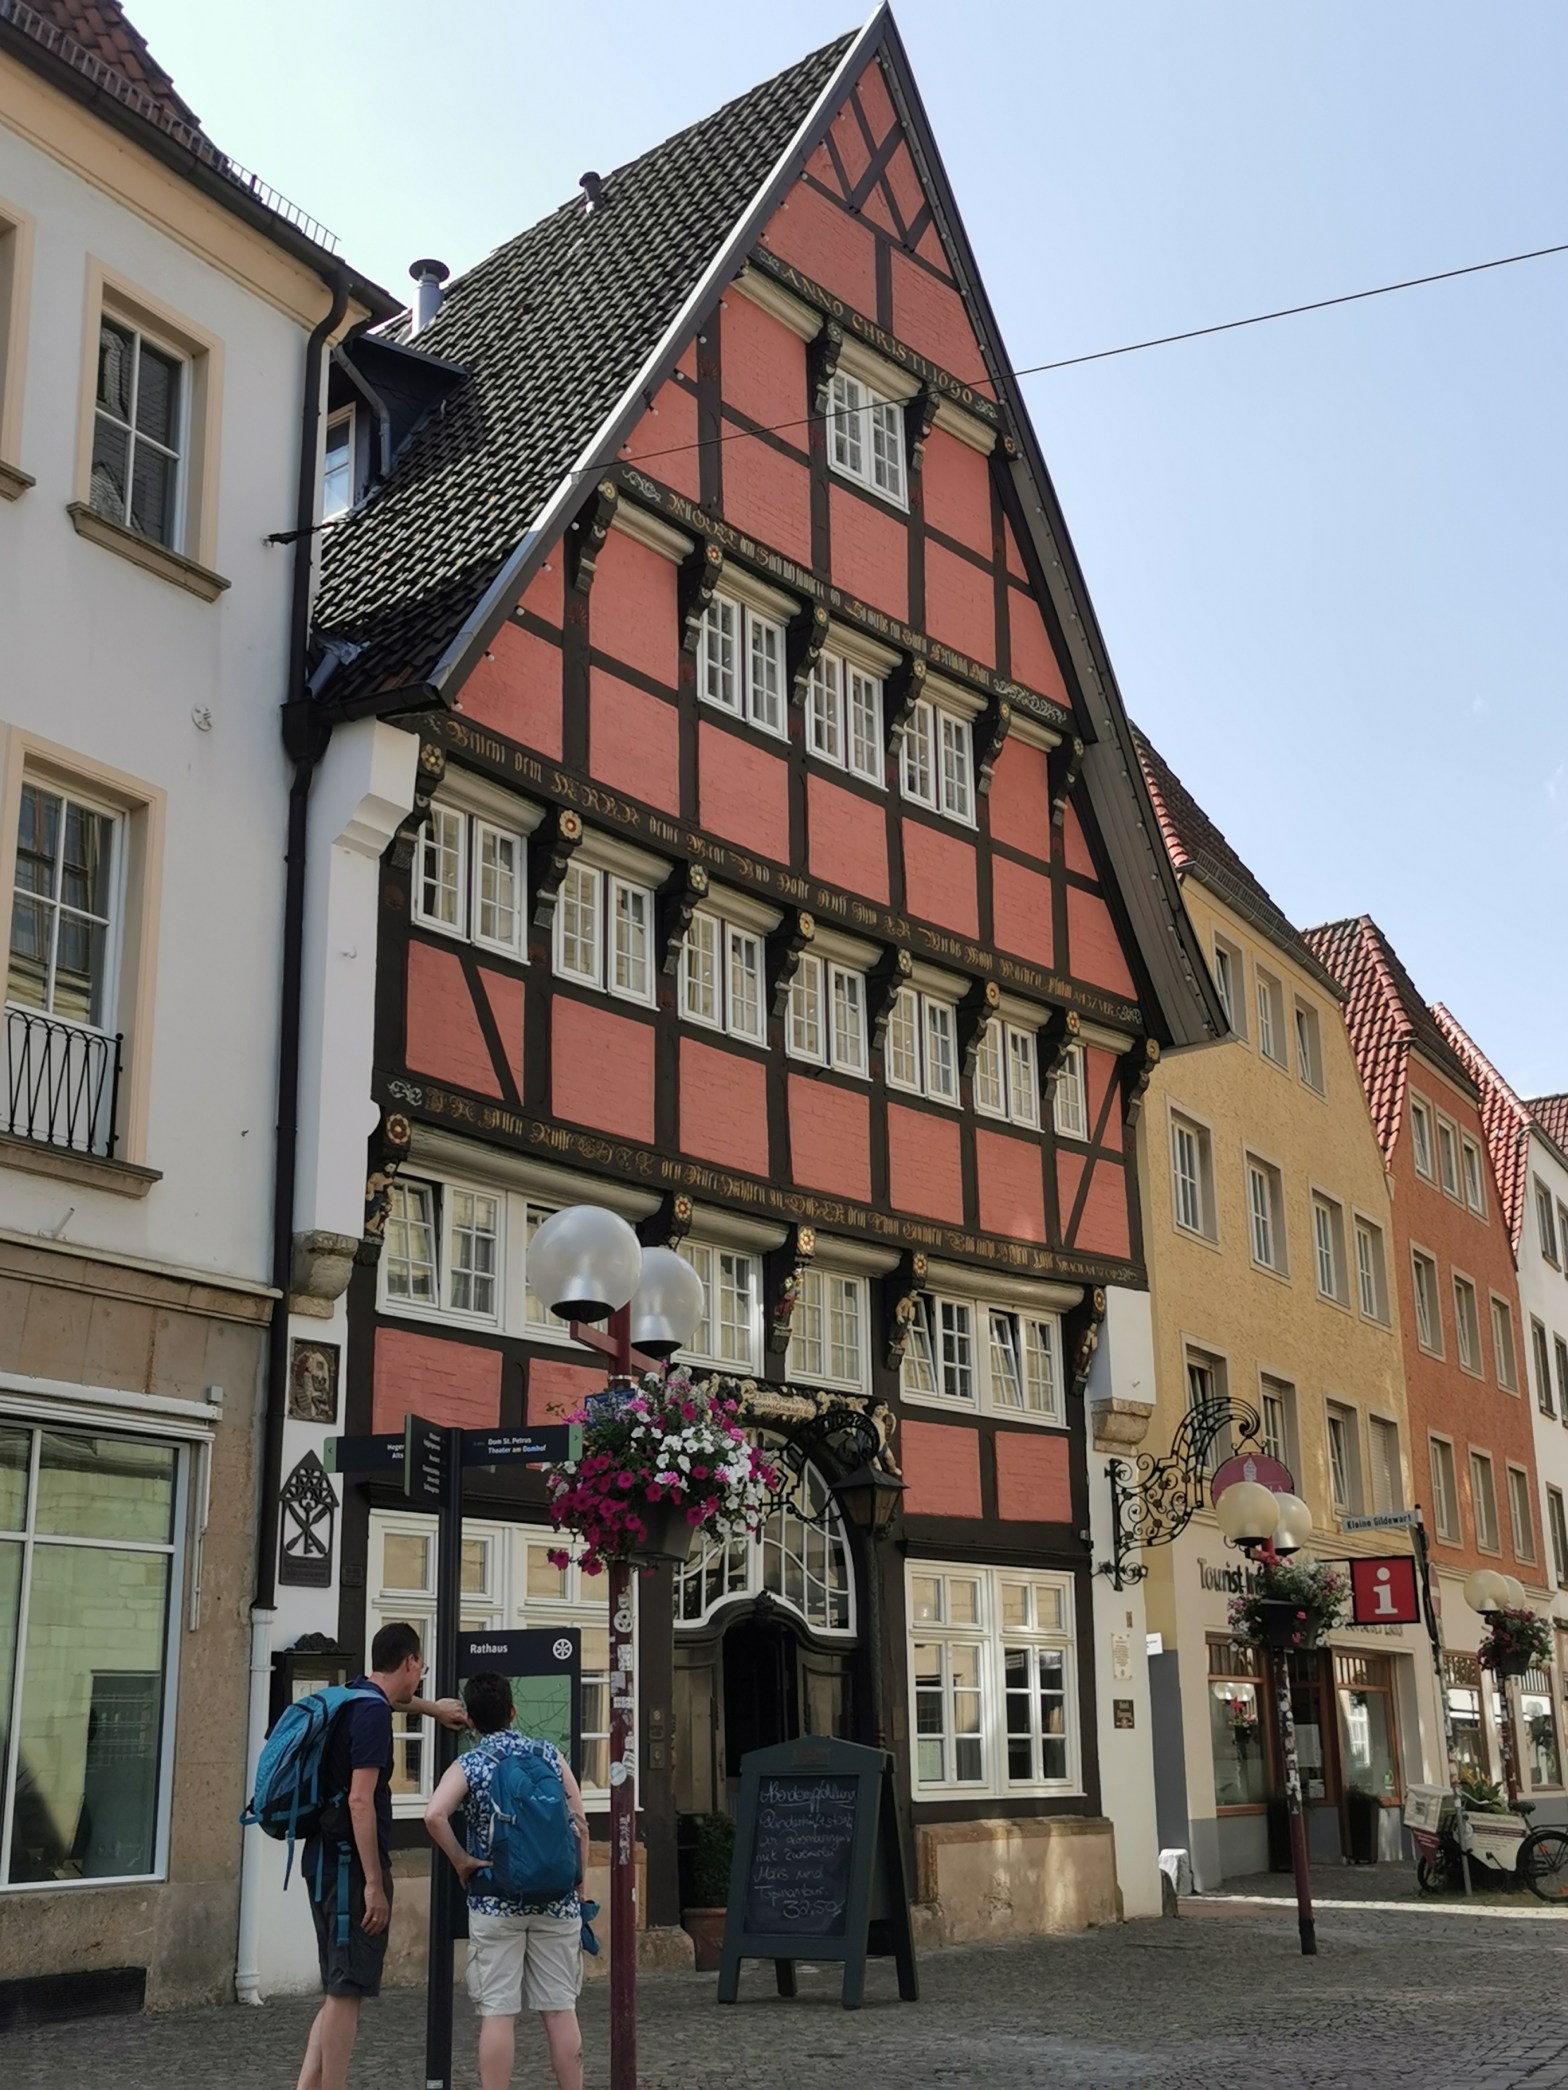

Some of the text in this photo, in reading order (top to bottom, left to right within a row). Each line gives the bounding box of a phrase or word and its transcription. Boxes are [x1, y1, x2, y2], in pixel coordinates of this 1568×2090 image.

[784, 268, 845, 317] ANNO
[488, 1438, 502, 1446] Dom
[503, 1437, 512, 1445] St.
[512, 1437, 532, 1445] Petrus
[488, 1446, 511, 1454] Theater
[522, 1444, 547, 1453] Domhof
[1347, 1514, 1412, 1530] Kleine Gildewart
[470, 1643, 508, 1654] Rathaus
